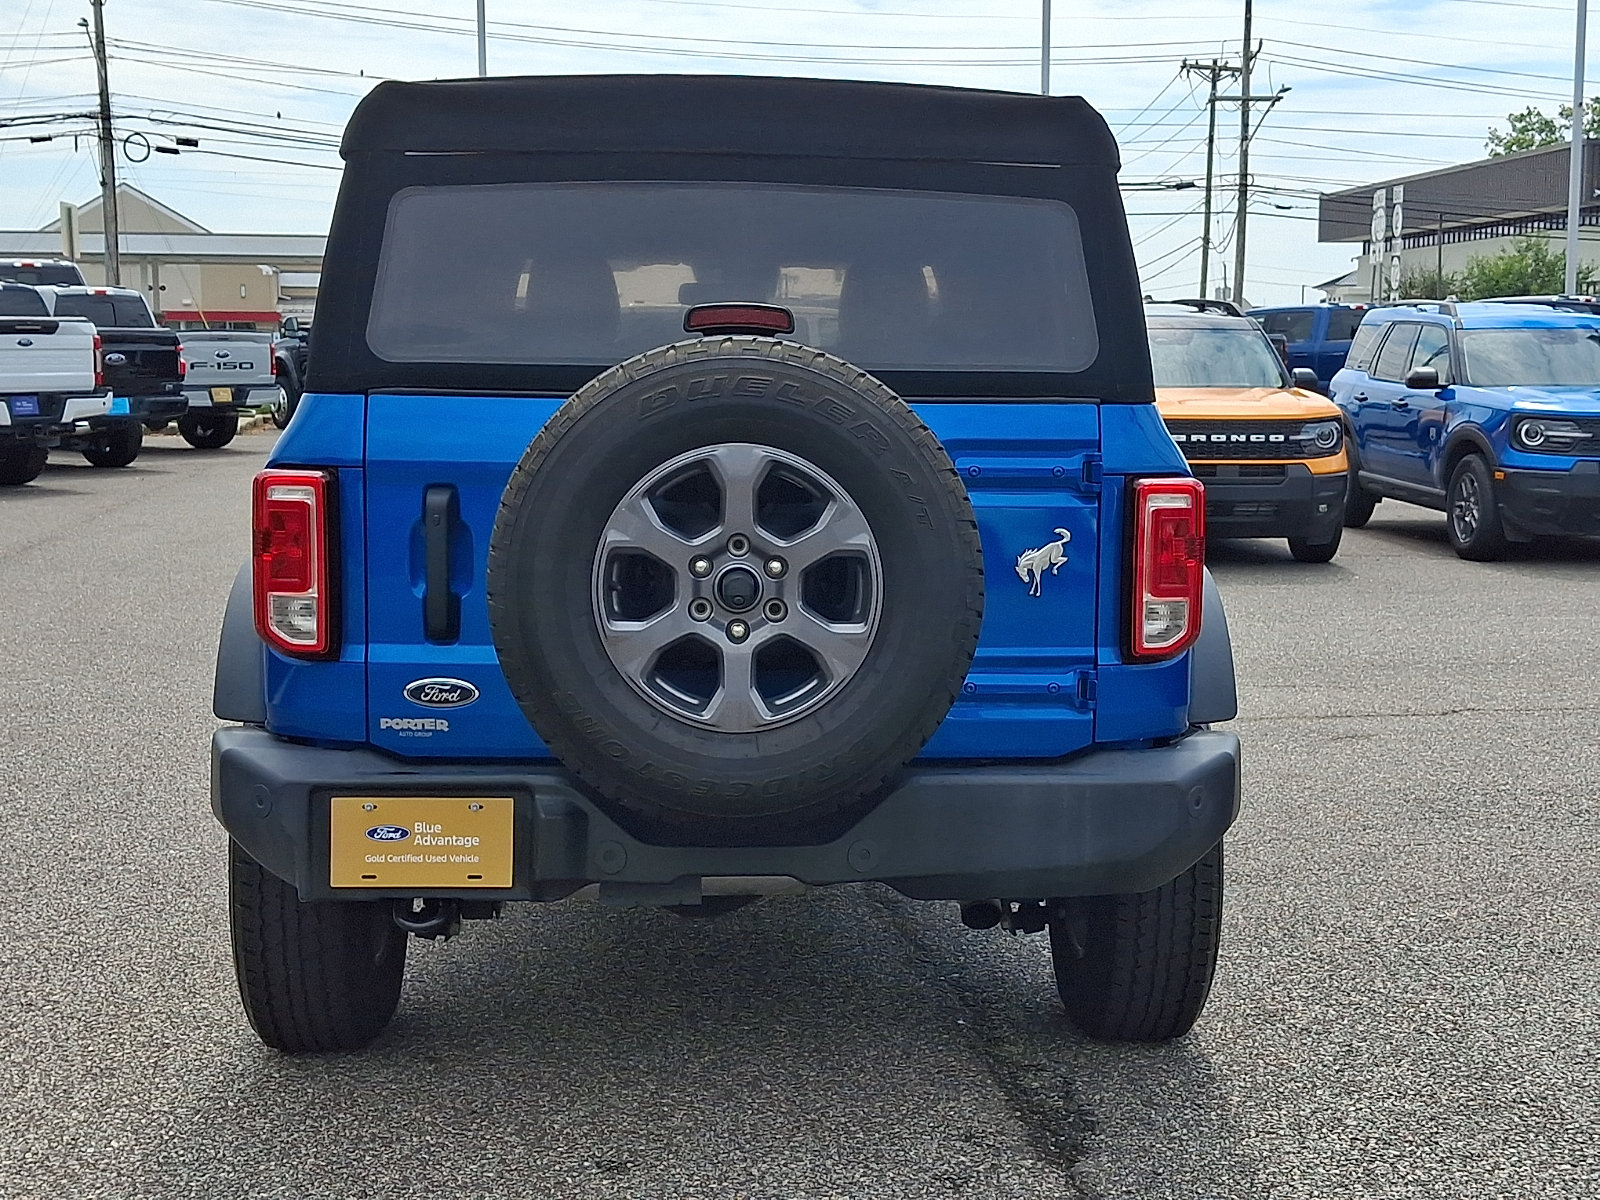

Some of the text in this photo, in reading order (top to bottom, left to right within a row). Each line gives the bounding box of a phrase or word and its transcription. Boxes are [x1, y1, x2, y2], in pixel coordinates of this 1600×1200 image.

[190, 361, 254, 370] F-150
[637, 375, 892, 456] DUELER
[380, 717, 449, 732] PORTER
[552, 688, 866, 801] RIDGESTONE
[414, 821, 442, 833] Blue
[413, 834, 480, 848] Advantage
[364, 854, 480, 863] Gold Certified Used Vehicle
